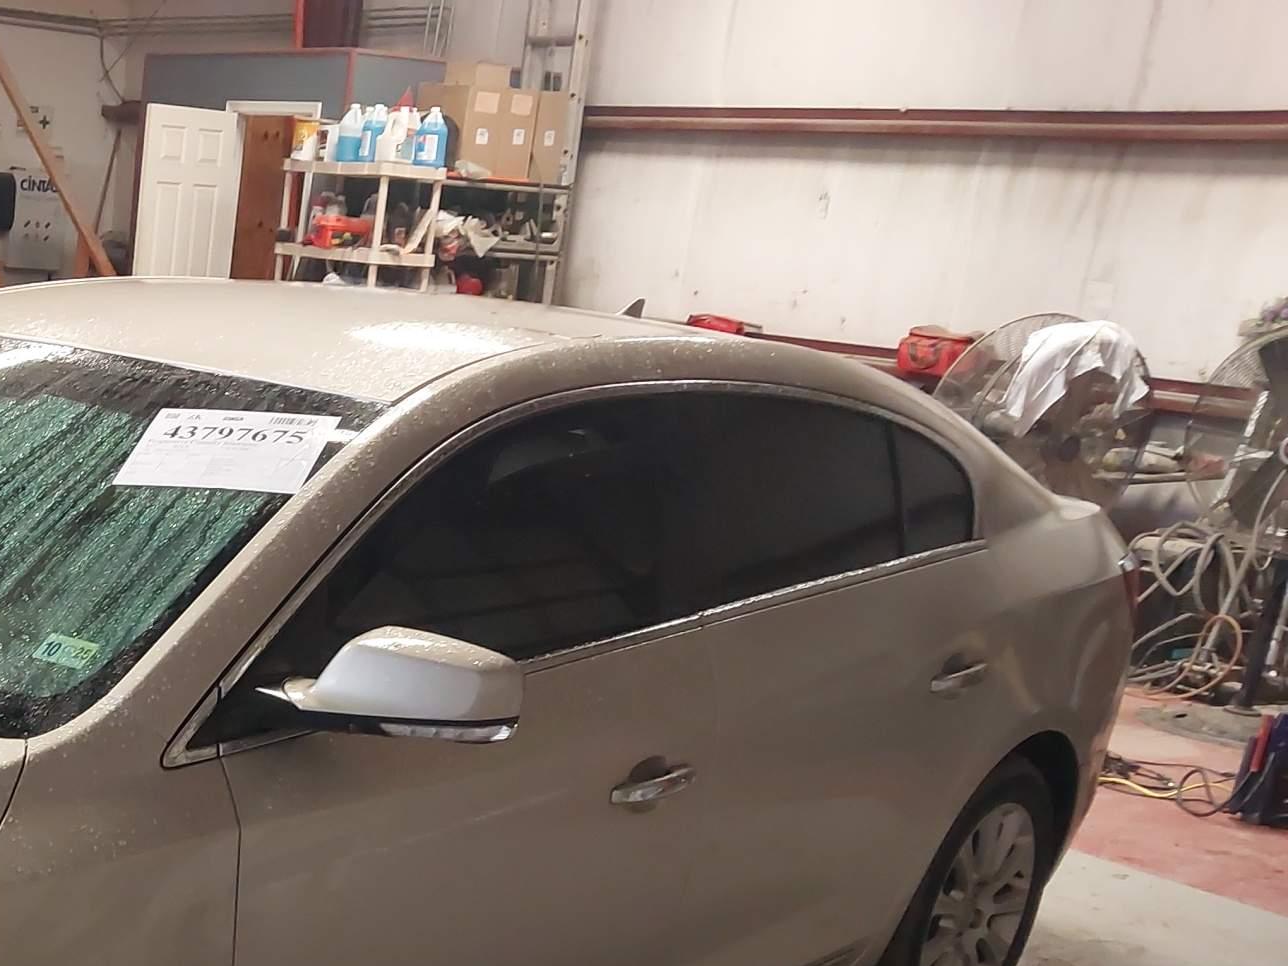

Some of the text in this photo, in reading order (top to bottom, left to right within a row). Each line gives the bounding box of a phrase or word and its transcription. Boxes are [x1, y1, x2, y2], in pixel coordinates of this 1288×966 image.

[20, 175, 60, 193] CINTA
[163, 425, 309, 444] 43797675
[41, 640, 62, 656] 10
